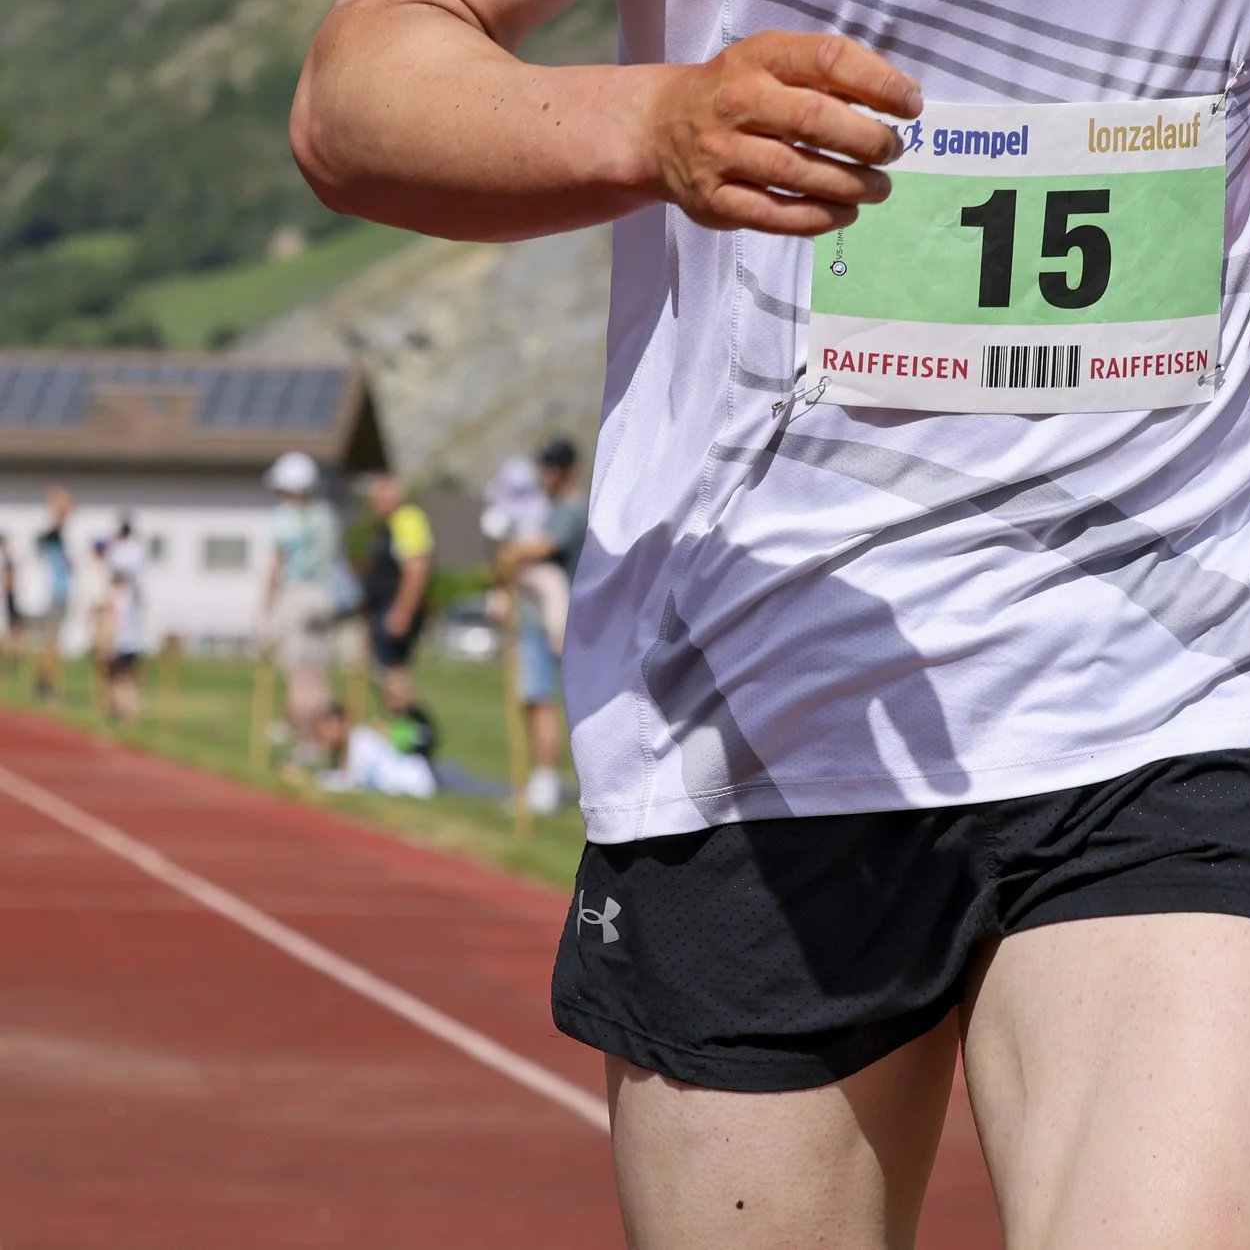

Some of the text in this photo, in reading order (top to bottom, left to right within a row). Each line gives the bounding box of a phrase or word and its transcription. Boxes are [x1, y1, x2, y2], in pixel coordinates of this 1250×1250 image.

[933, 125, 1029, 159] gampel
[1088, 112, 1201, 153] lonzalauf
[960, 189, 1112, 309] 15
[822, 348, 968, 380] RAIFFEISEN
[1090, 349, 1208, 379] RAIFFEISEN
